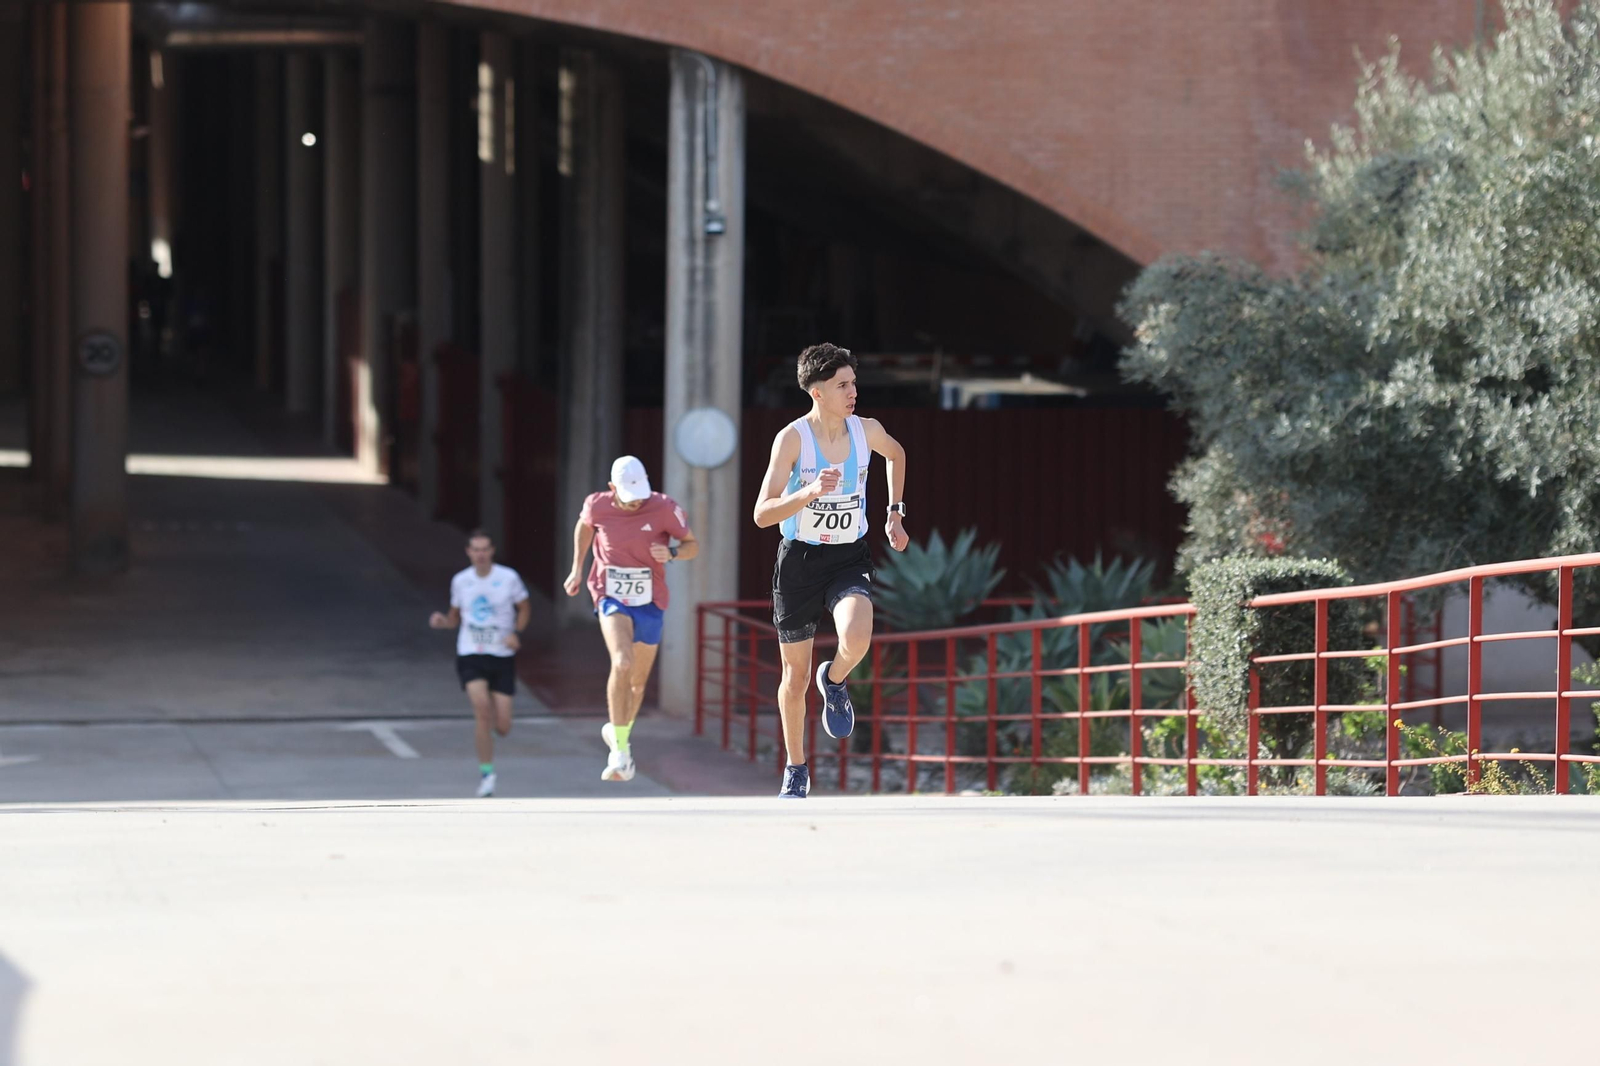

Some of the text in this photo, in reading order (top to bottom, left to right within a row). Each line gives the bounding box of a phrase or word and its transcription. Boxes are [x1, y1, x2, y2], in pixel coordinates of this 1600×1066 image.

[87, 342, 115, 363] 20
[813, 512, 852, 530] 700
[614, 581, 645, 595] 276
